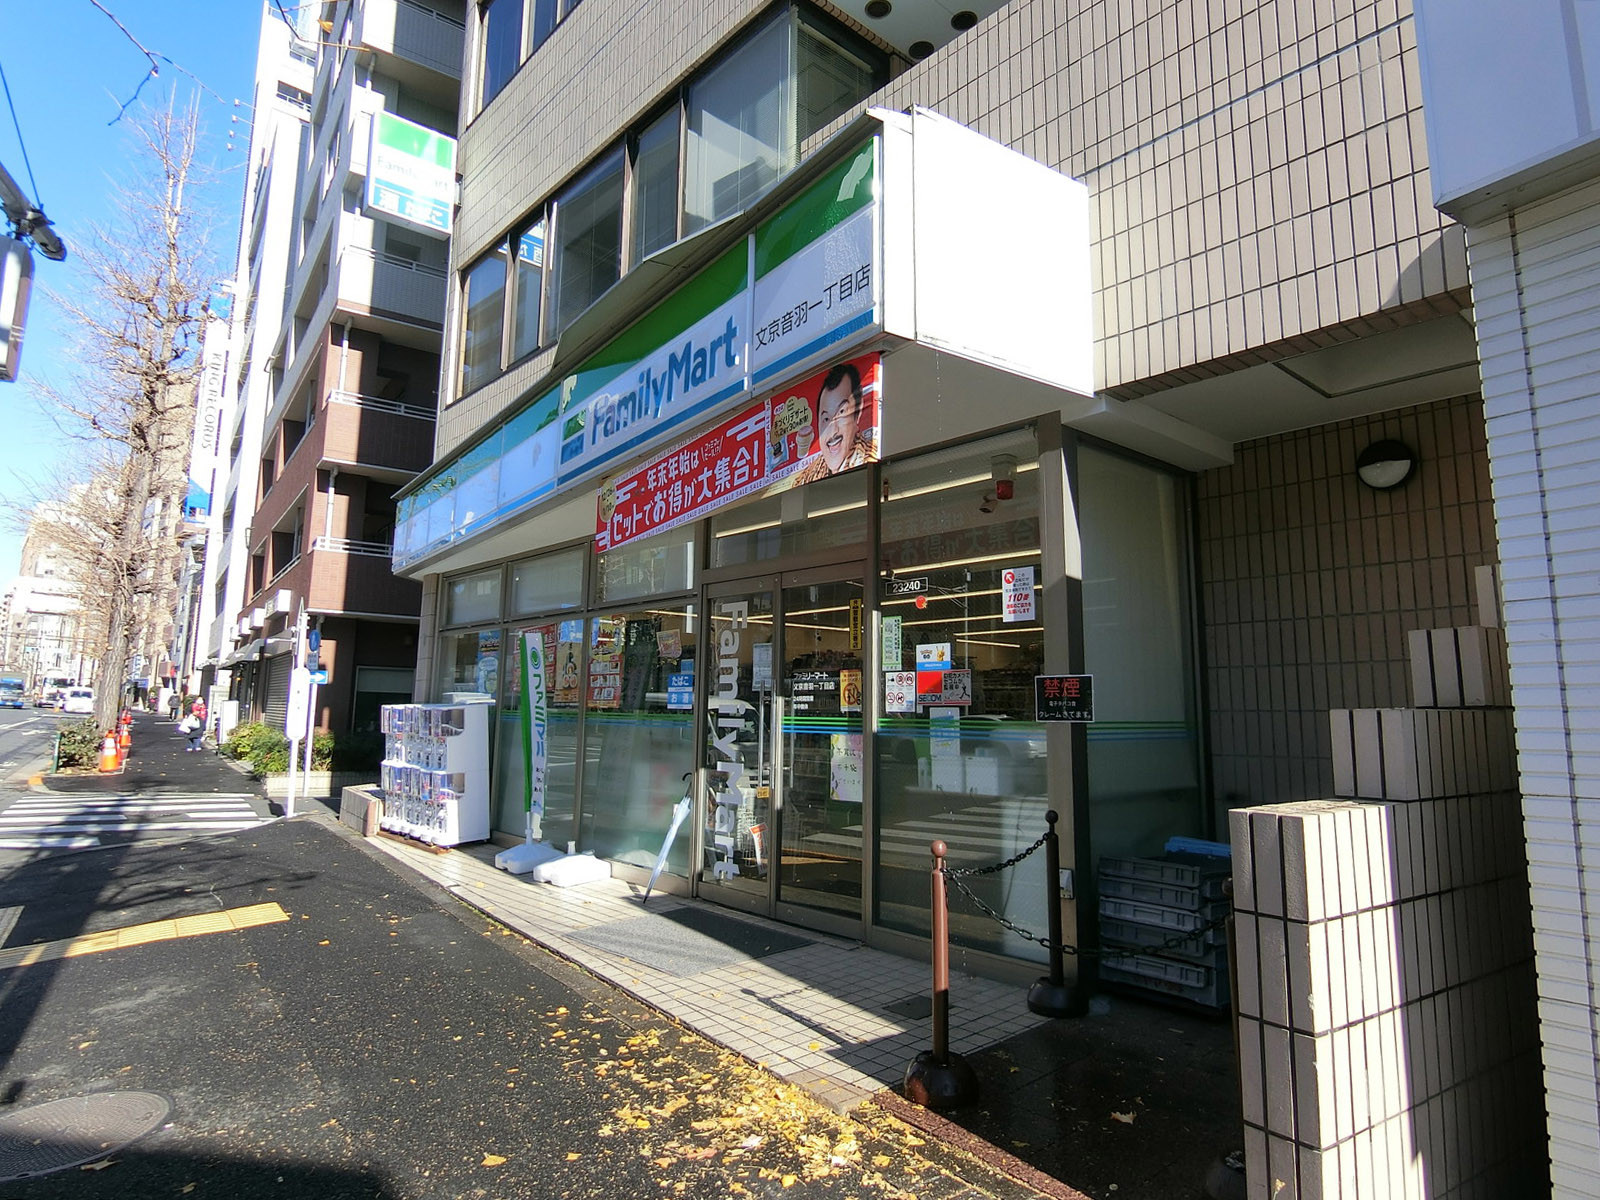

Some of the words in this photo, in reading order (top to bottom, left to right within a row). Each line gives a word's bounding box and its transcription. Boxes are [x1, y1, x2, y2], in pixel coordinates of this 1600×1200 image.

[755, 263, 871, 351] 文京音羽一丁目店
[209, 352, 222, 387] KING
[591, 315, 738, 446] FamilyMart
[201, 388, 218, 450] RECORDS
[647, 449, 699, 492] 年末年始は
[613, 440, 759, 542] セットでお得が大集合!
[892, 580, 921, 592] 23240
[671, 676, 690, 686] たばこ
[793, 672, 828, 680] ファミリーマート
[1044, 678, 1080, 697] 禁煙
[918, 694, 942, 702] SECOM
[713, 600, 748, 880] FamilyMart
